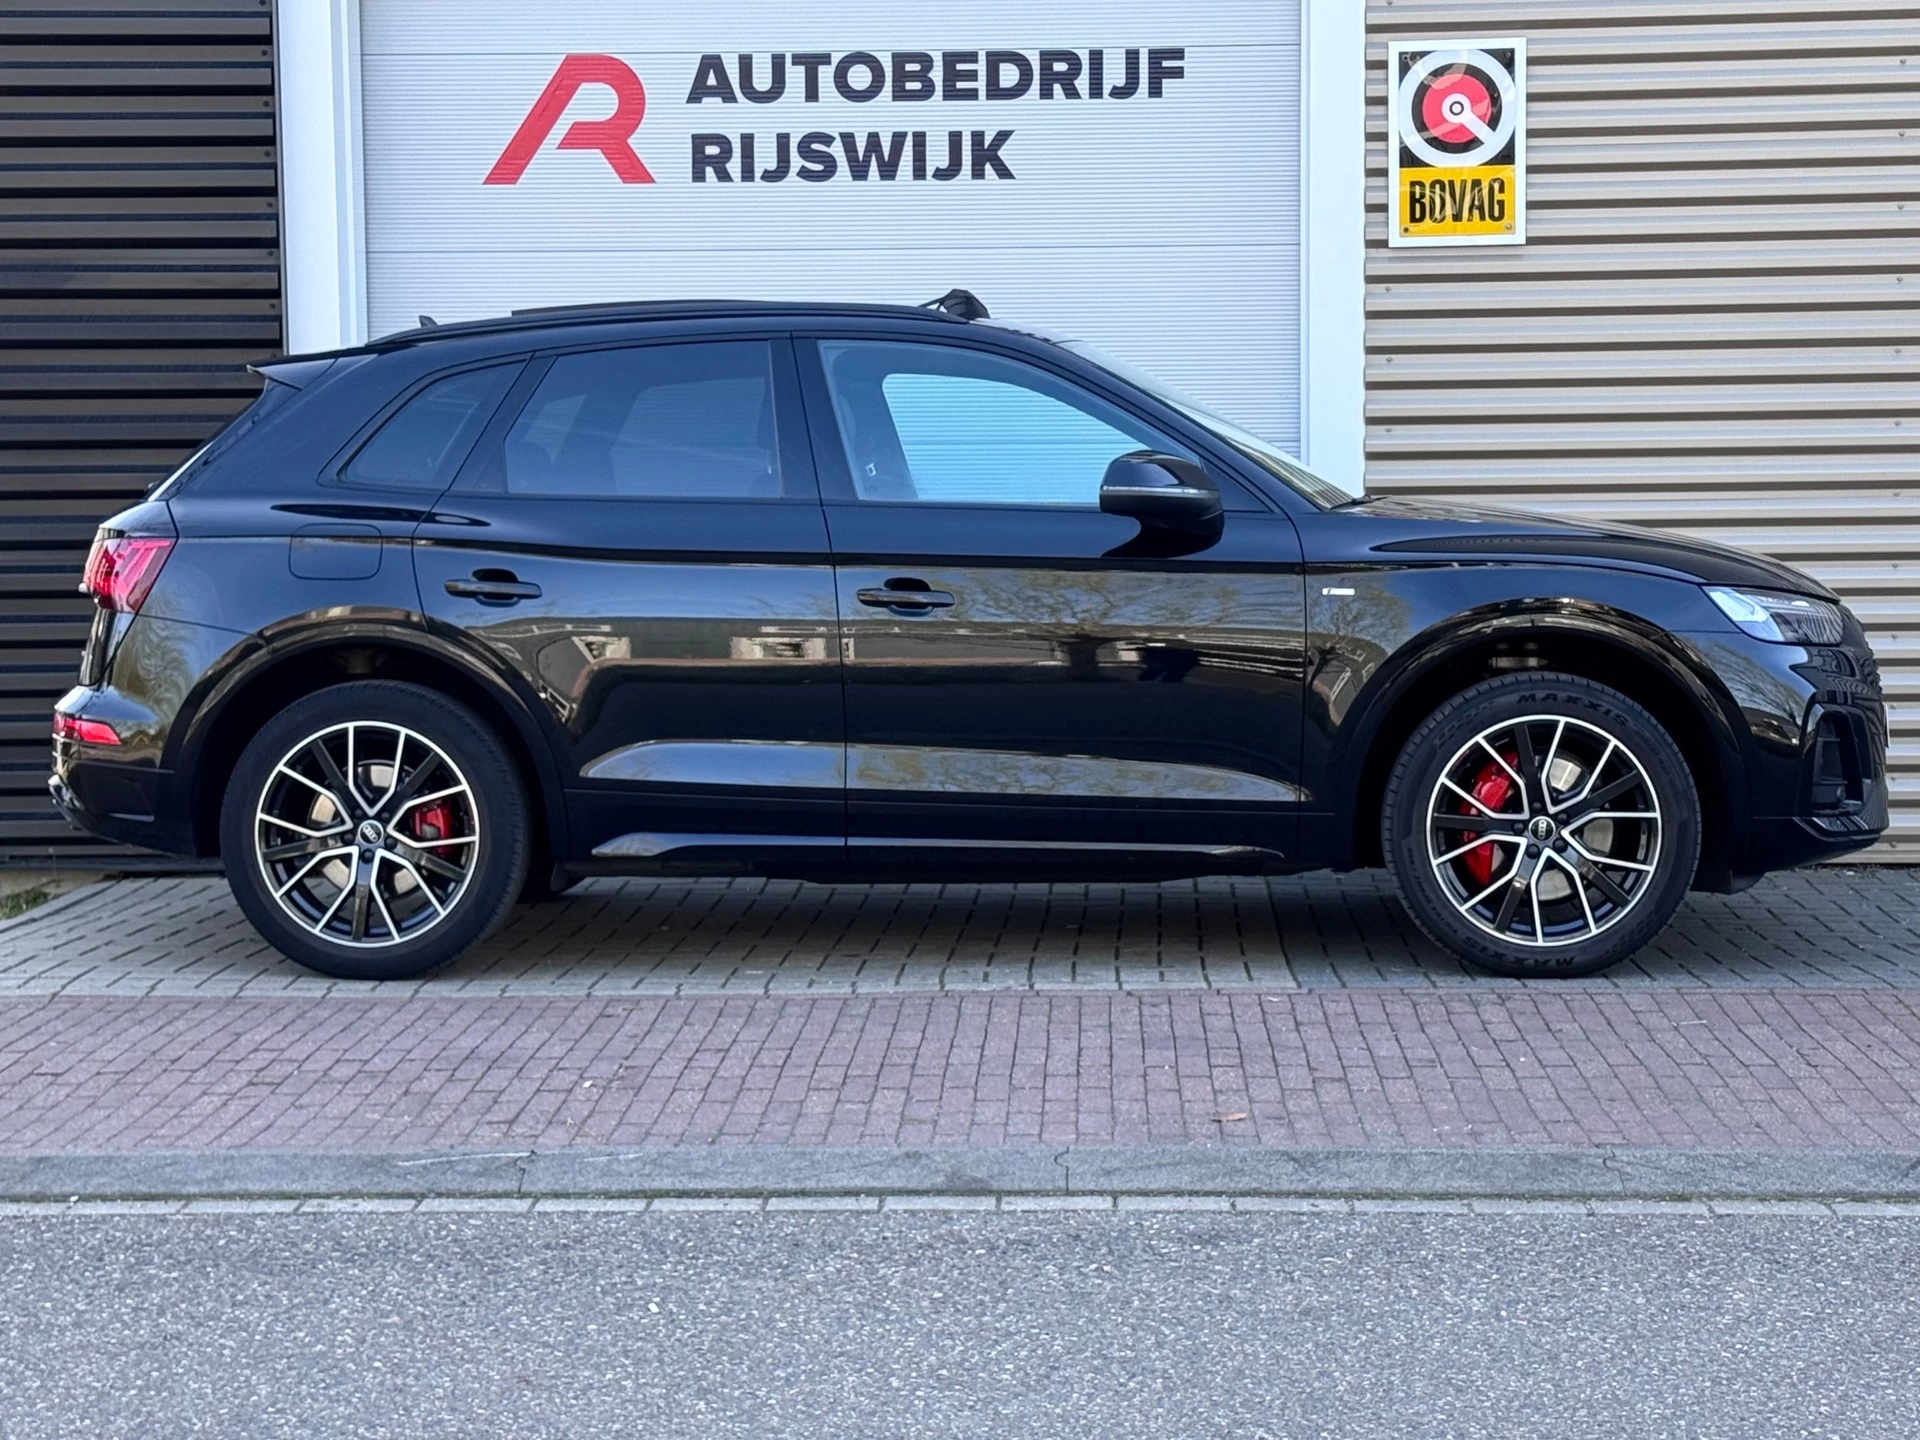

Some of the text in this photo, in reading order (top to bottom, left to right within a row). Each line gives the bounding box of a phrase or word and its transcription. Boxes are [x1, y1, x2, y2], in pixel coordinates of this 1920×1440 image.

[686, 47, 1186, 104] AUTOBEDRIJF
[691, 129, 1016, 183] RIJSWIJK
[1409, 178, 1505, 223] BOVAG
[1517, 693, 1629, 726] MAXXIS
